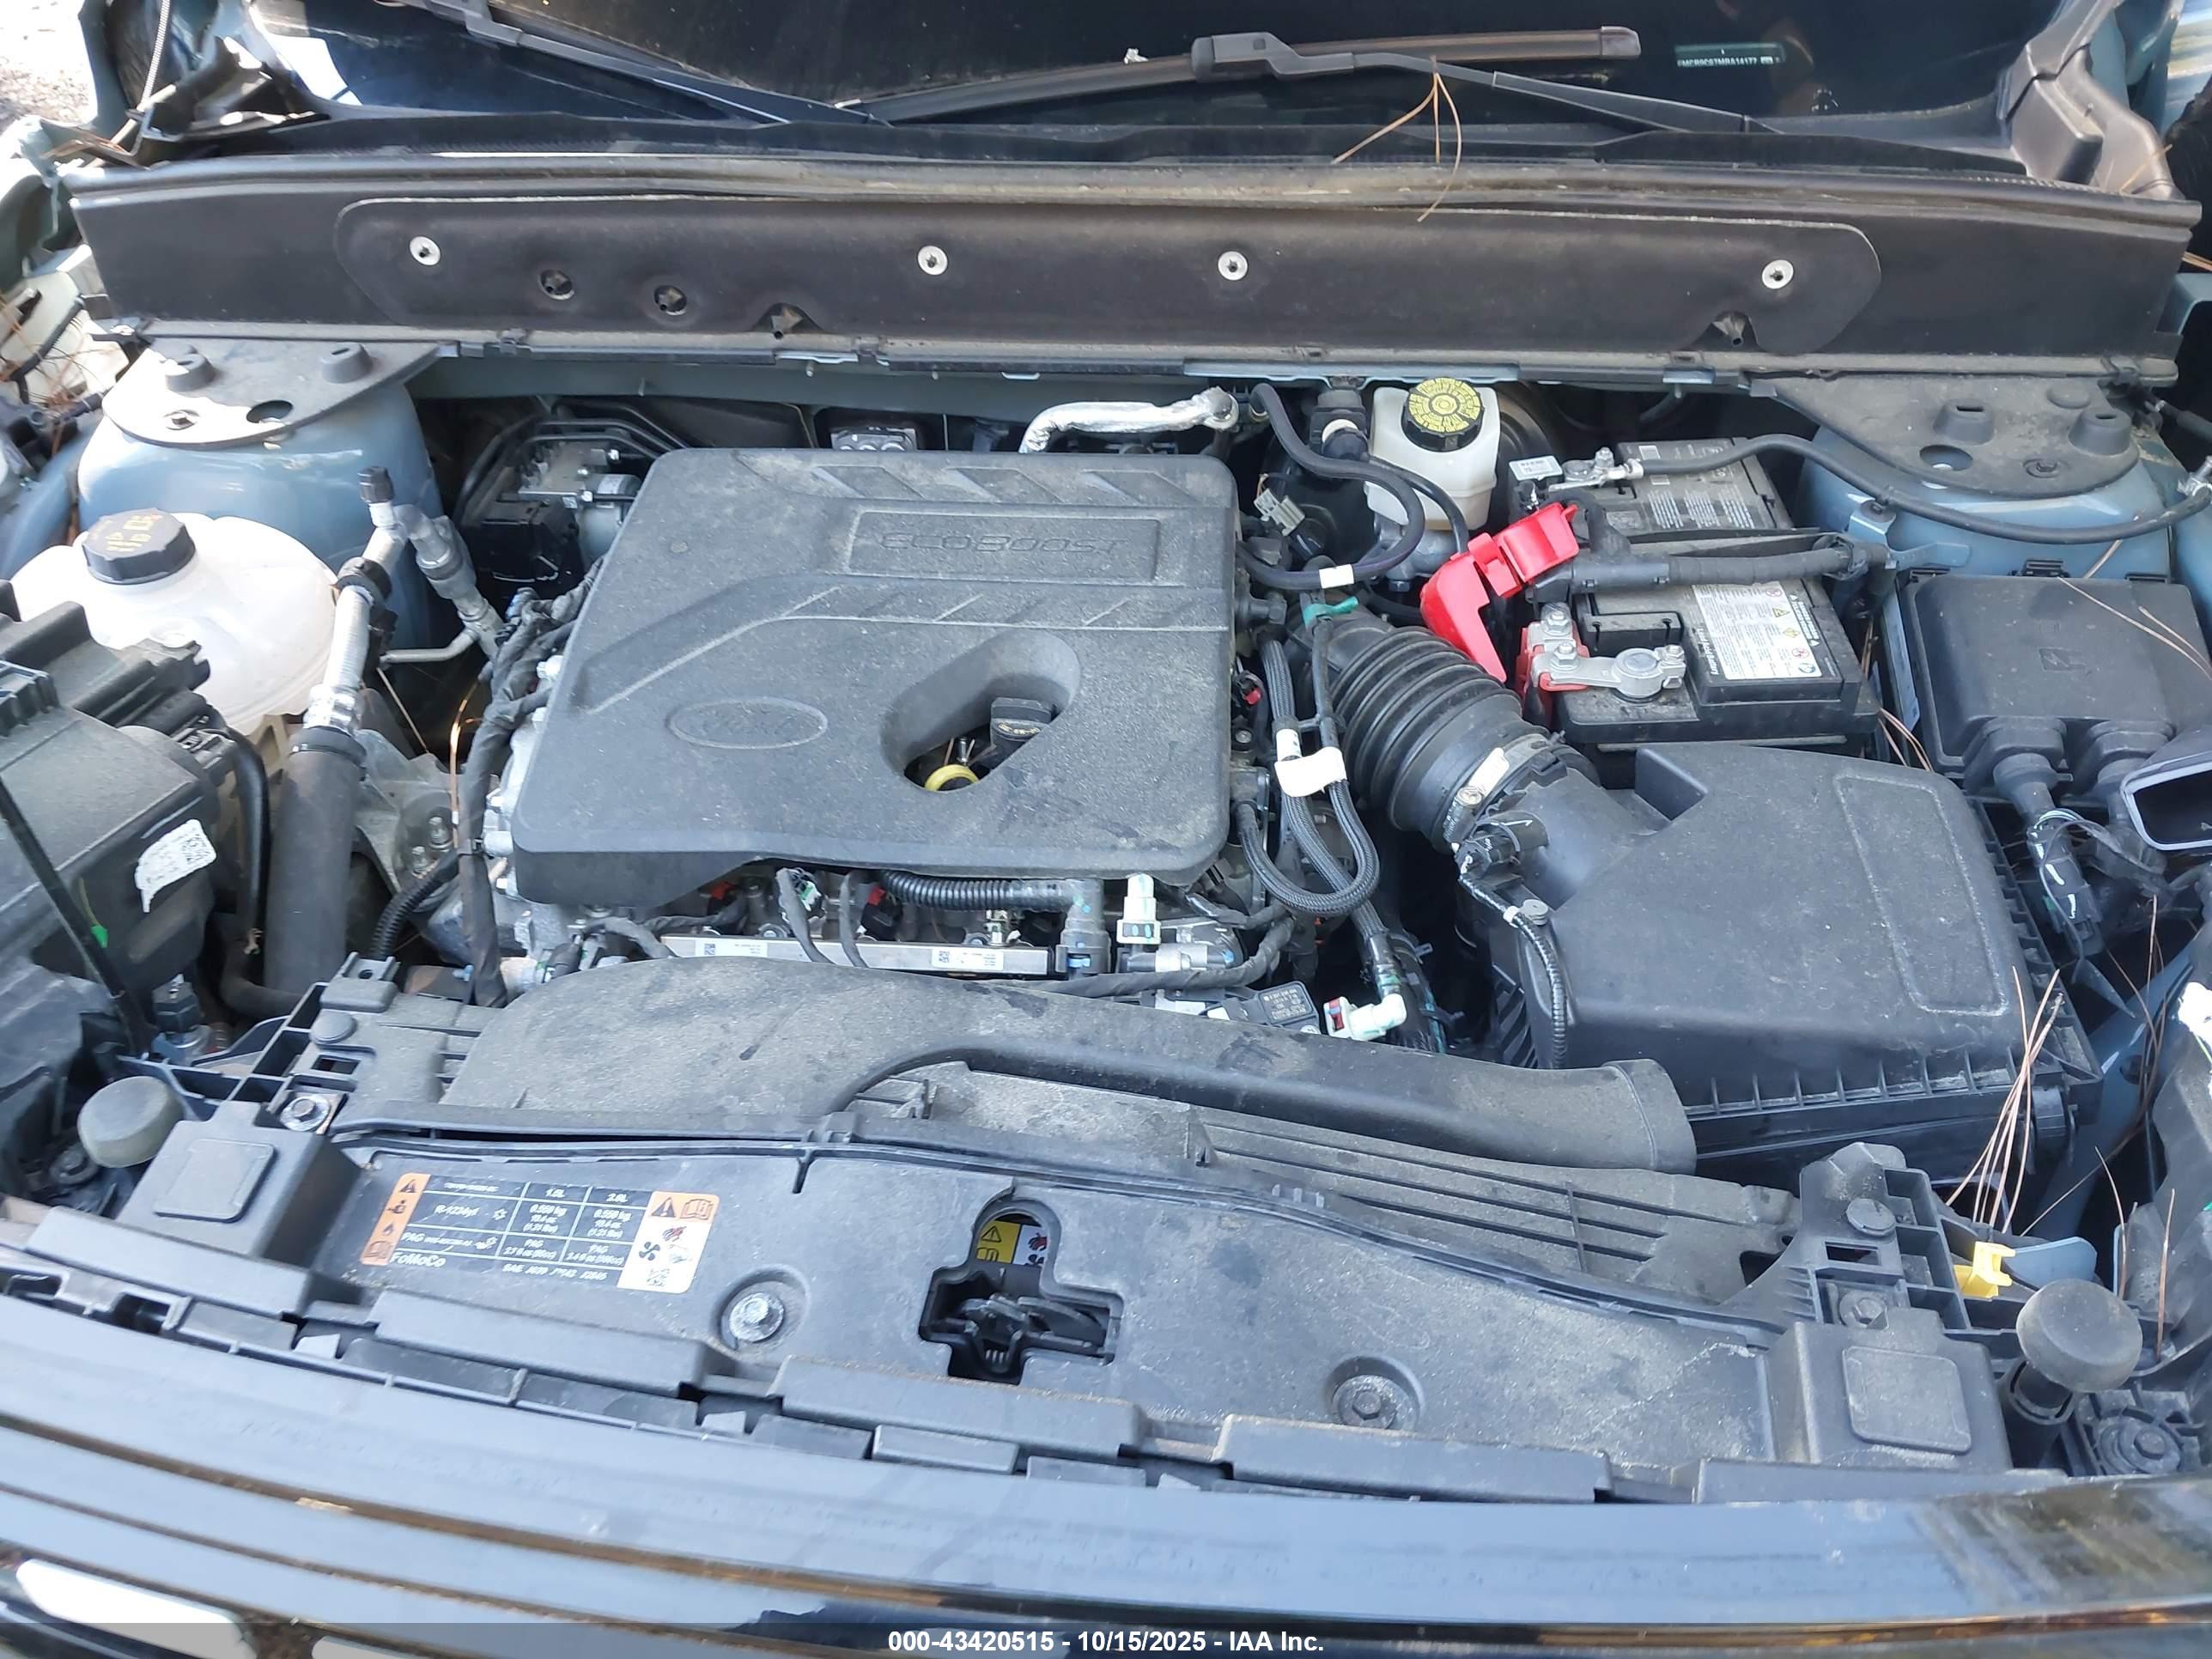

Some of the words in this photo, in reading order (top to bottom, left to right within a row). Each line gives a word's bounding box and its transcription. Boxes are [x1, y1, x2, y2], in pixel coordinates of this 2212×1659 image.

[879, 532, 1130, 555] ECOBOOST
[401, 1232, 425, 1242] PAG
[524, 1239, 544, 1248] PAG
[588, 1245, 610, 1254] PAG
[389, 1252, 447, 1267] FoMoCo
[502, 1263, 525, 1273] SAE
